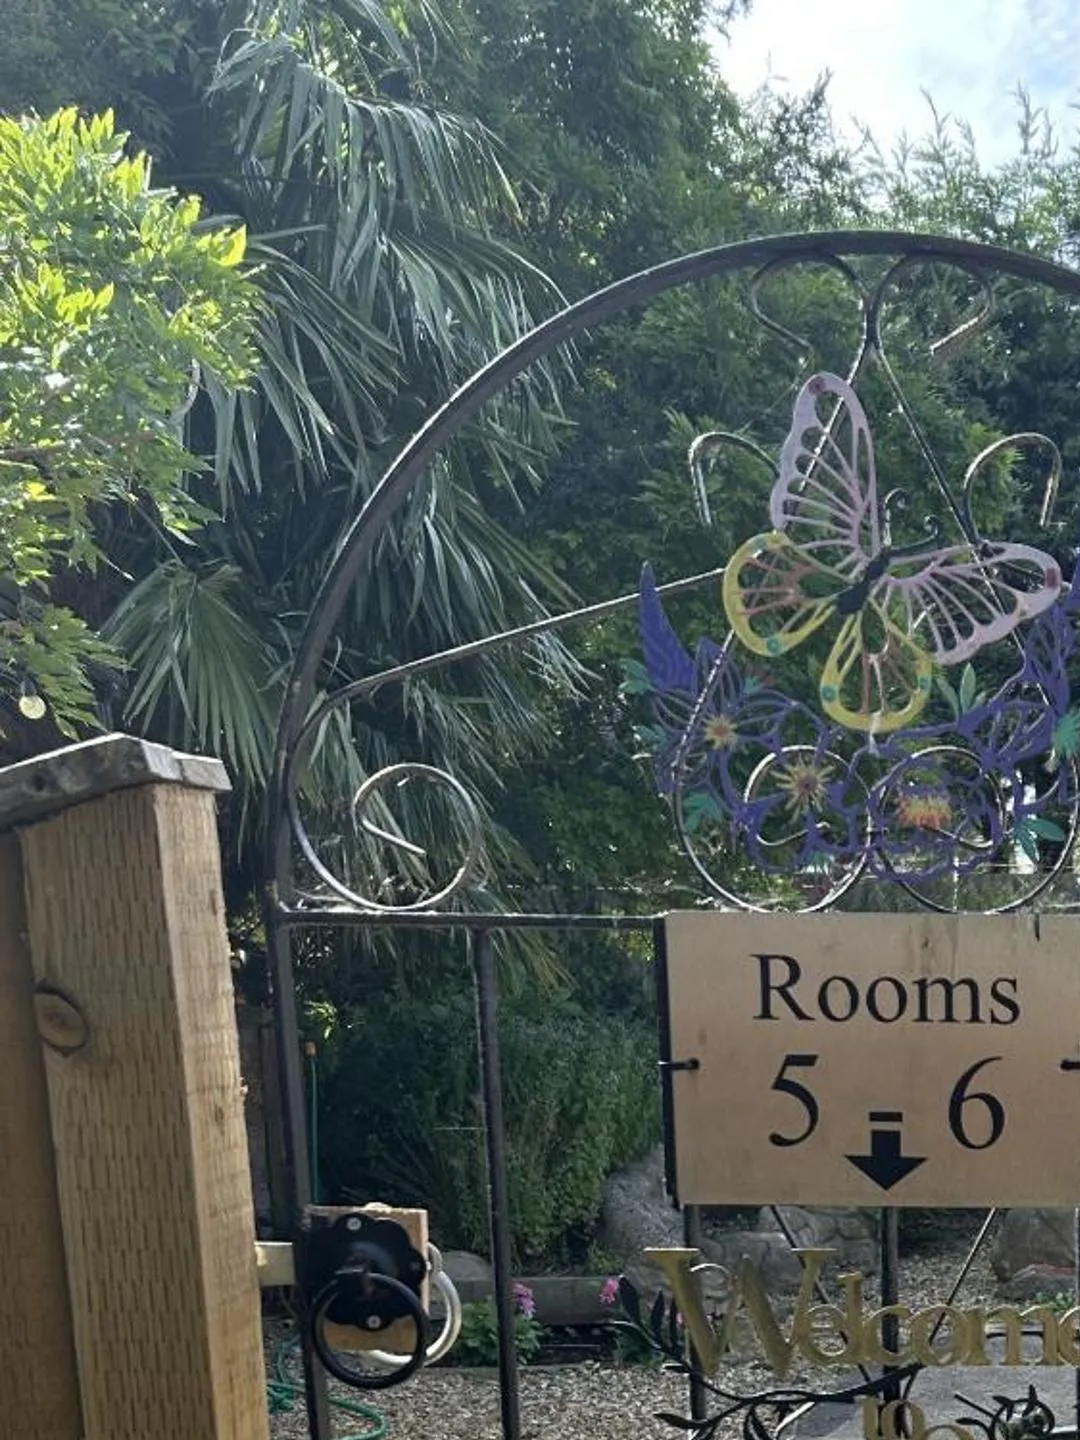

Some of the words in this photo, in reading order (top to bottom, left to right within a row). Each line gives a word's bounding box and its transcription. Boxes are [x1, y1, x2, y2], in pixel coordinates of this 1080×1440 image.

[750, 953, 1021, 1025] Rooms
[767, 1053, 819, 1148] 5
[948, 1055, 1006, 1150] 6
